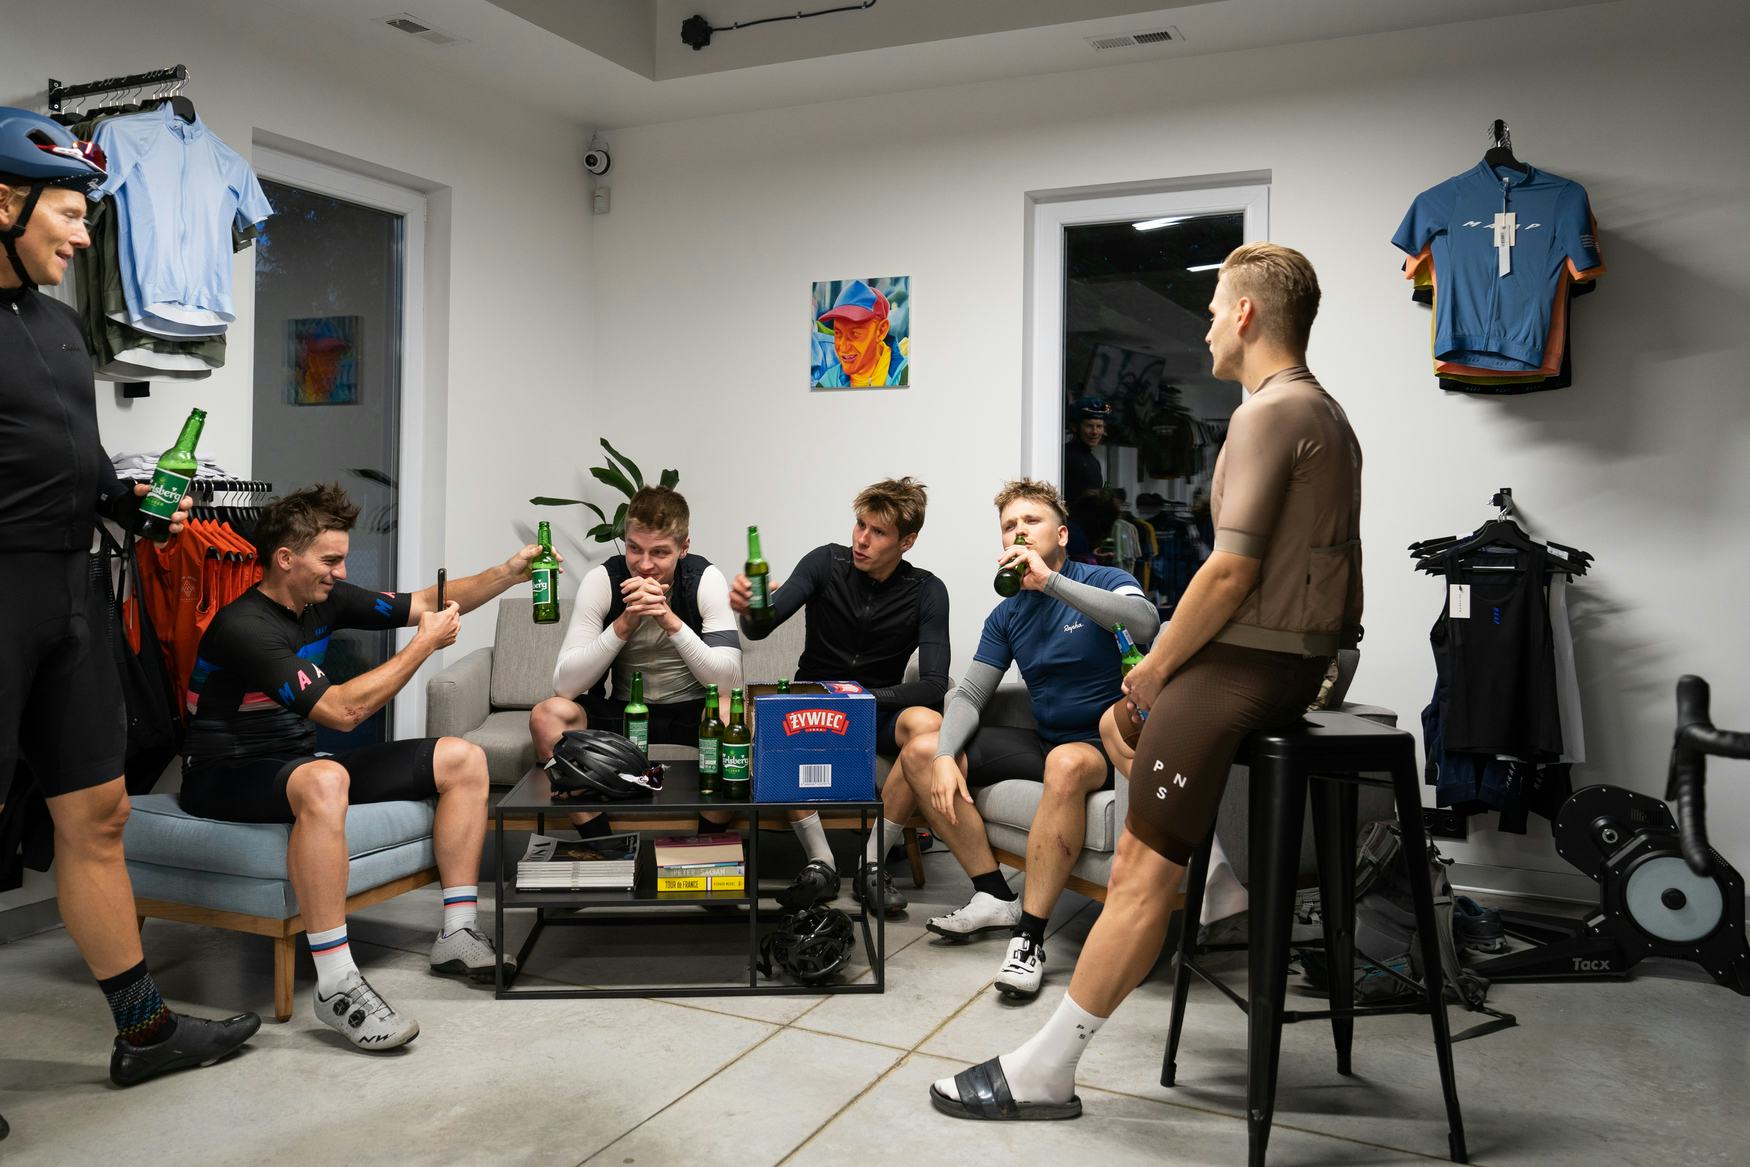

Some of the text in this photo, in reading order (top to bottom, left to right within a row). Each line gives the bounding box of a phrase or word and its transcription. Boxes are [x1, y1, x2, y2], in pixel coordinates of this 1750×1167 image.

[1462, 220, 1541, 230] MAP
[789, 711, 843, 729] ŻYWIEC
[1572, 957, 1611, 970] Tacx
